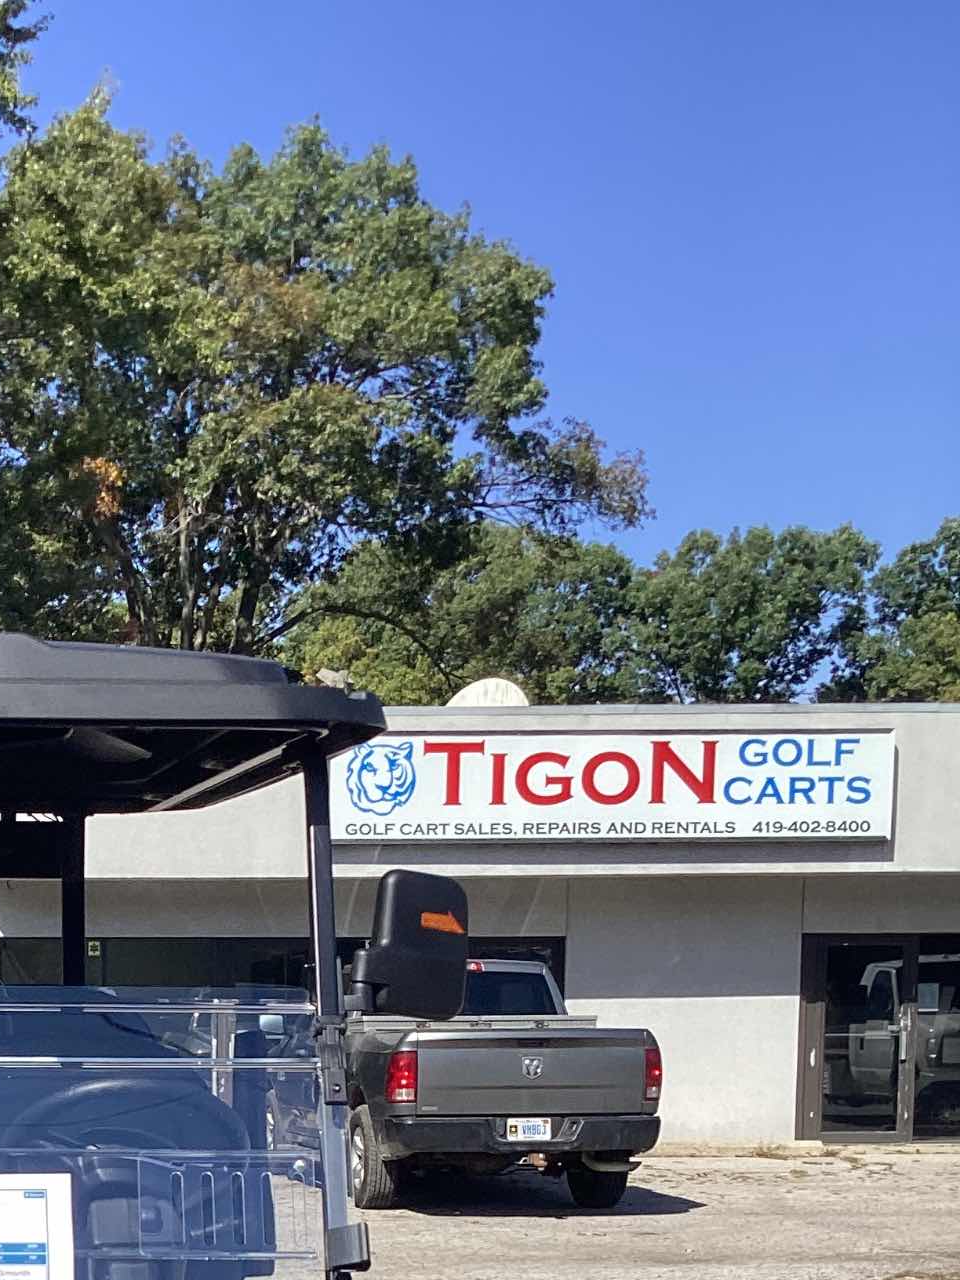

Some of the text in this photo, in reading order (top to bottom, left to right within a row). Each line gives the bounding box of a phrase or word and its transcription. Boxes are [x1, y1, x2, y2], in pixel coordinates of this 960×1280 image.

[738, 738, 861, 767] GOLF
[723, 775, 872, 805] CARTS
[345, 820, 871, 836] GOLF CART SALES, REPAIRS AND RENTALS 419-402-8400
